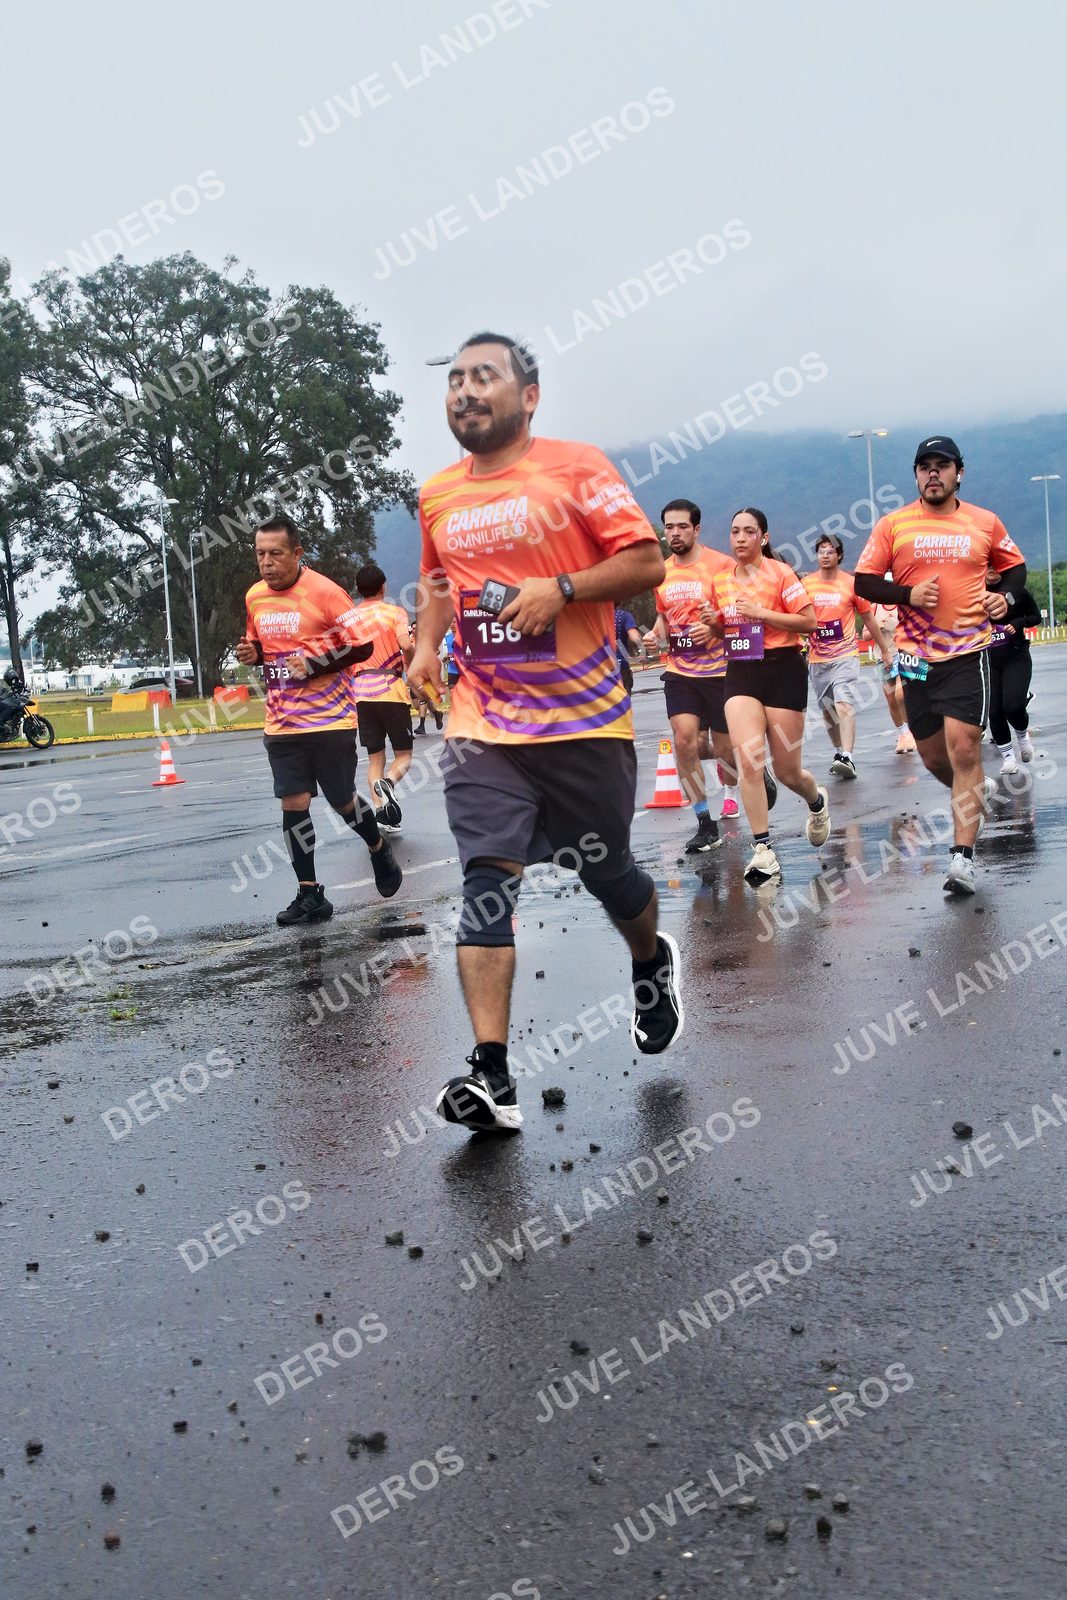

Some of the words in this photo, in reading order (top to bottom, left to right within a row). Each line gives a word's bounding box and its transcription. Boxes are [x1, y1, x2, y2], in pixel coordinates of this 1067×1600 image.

[447, 495, 528, 534] CARRERA
[447, 525, 510, 550] OMNILIFE
[914, 535, 971, 549] CARRERA
[914, 549, 958, 558] OMNILIFE
[666, 582, 703, 596] CARRERA
[260, 612, 301, 626] CARRERA
[478, 621, 521, 643] 156
[820, 629, 835, 637] 538
[677, 638, 692, 648] 475
[731, 639, 750, 650] 688
[899, 652, 919, 668] 200
[269, 668, 290, 679] 373
